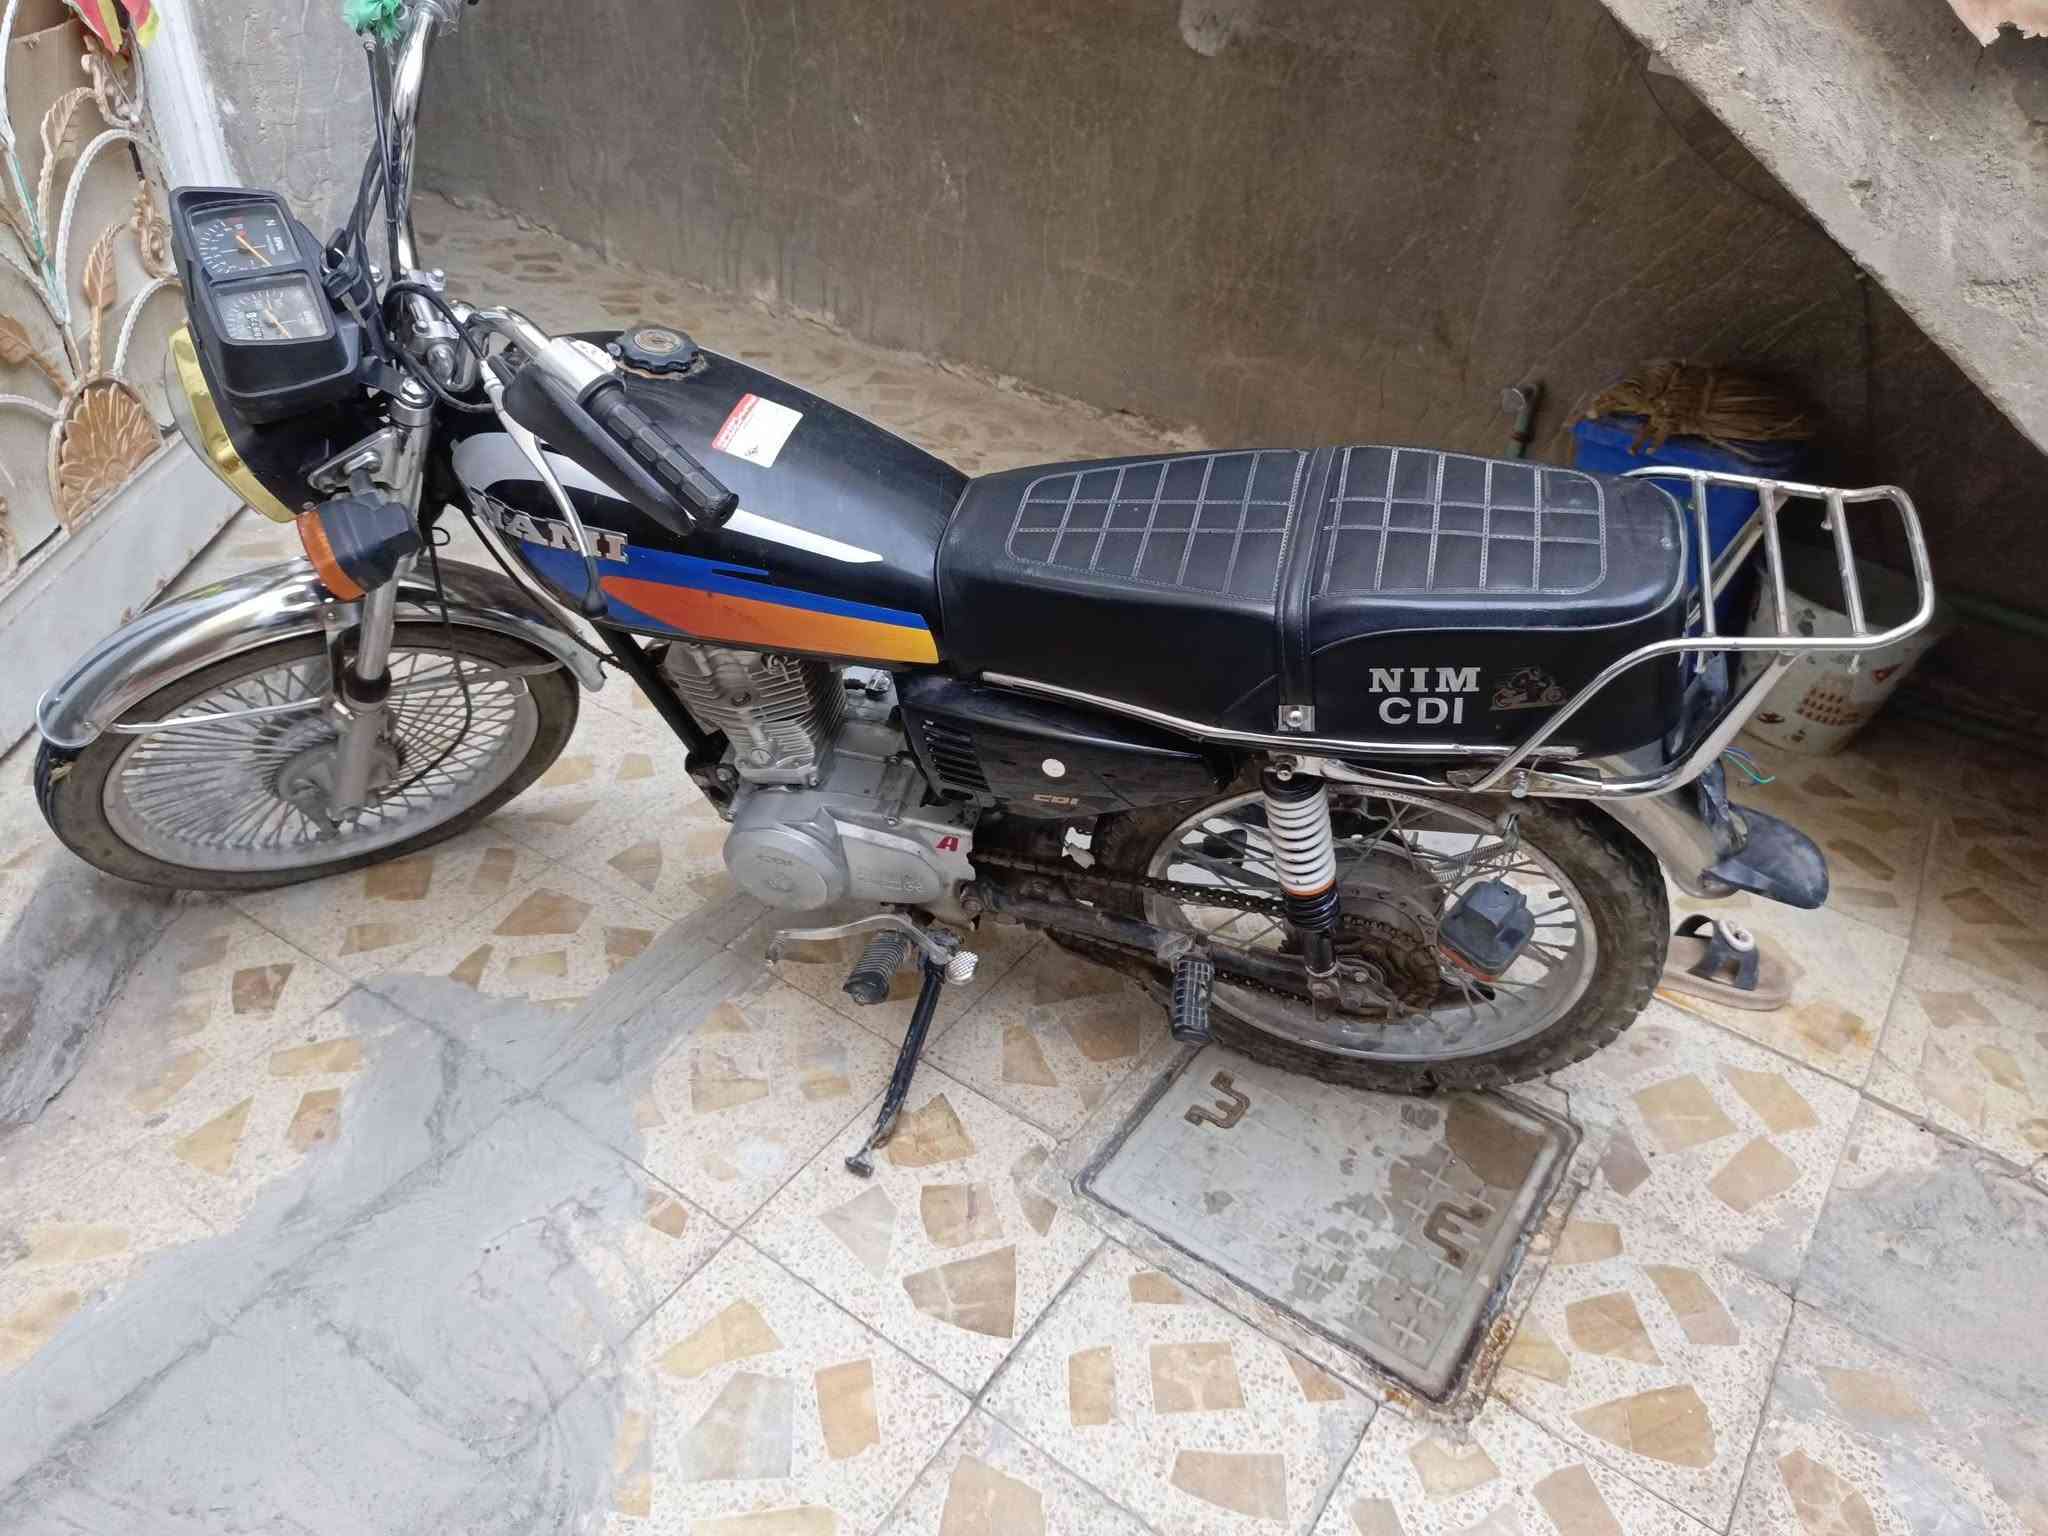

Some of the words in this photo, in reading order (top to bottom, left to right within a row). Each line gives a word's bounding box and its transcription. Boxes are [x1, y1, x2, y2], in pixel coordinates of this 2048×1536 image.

[1368, 667, 1481, 693] NIM
[1378, 696, 1464, 724] CDI
[935, 835, 959, 852] A
